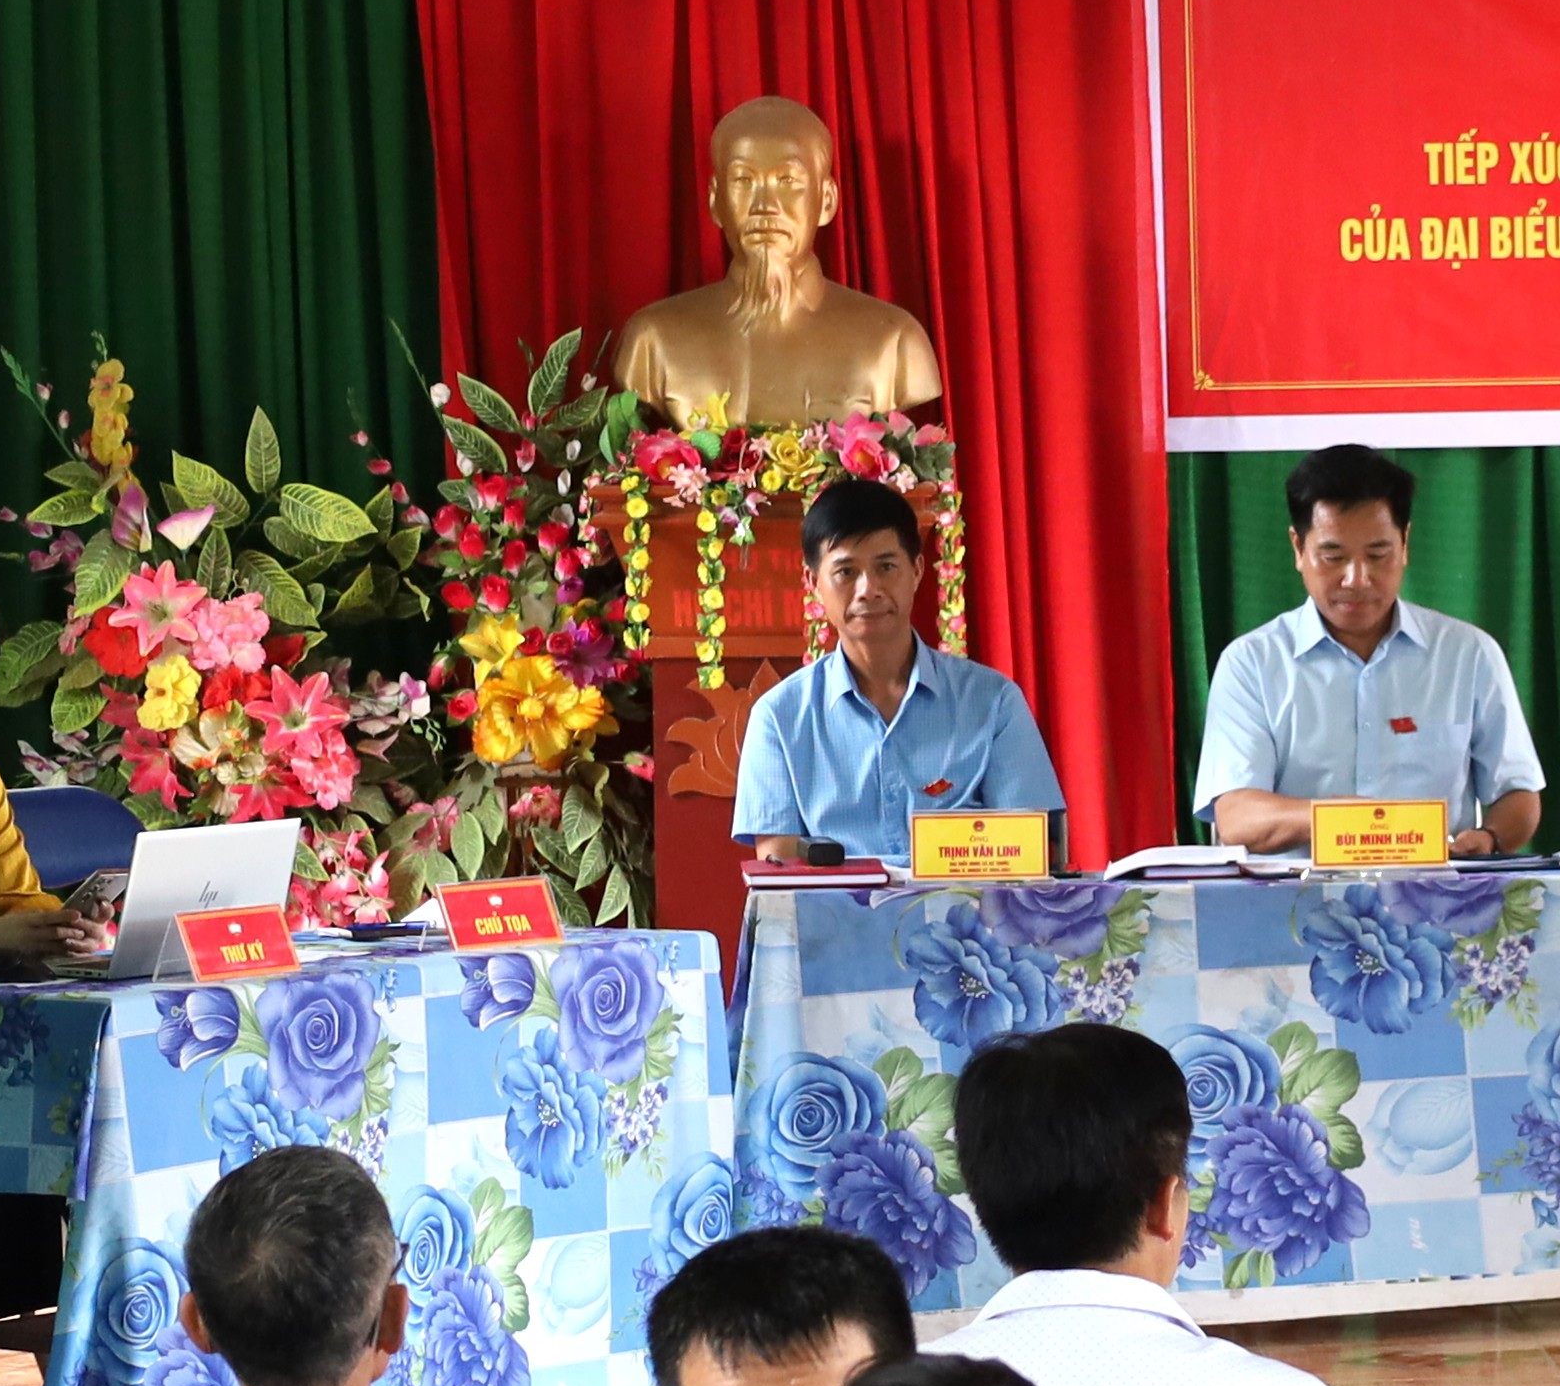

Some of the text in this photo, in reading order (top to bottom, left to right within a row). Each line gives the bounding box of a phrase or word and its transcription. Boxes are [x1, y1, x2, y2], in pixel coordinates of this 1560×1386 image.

[1423, 127, 1500, 186] TIẾP
[1340, 203, 1412, 263] CỦA
[1419, 215, 1480, 270] ĐẠI
[1336, 831, 1356, 846] BÙI
[1360, 833, 1392, 846] MINH
[938, 846, 970, 860] TRỊNH
[997, 845, 1021, 857] LINH
[474, 910, 532, 939] CHỦ TỌA
[220, 939, 265, 964] THƯ KÝ
